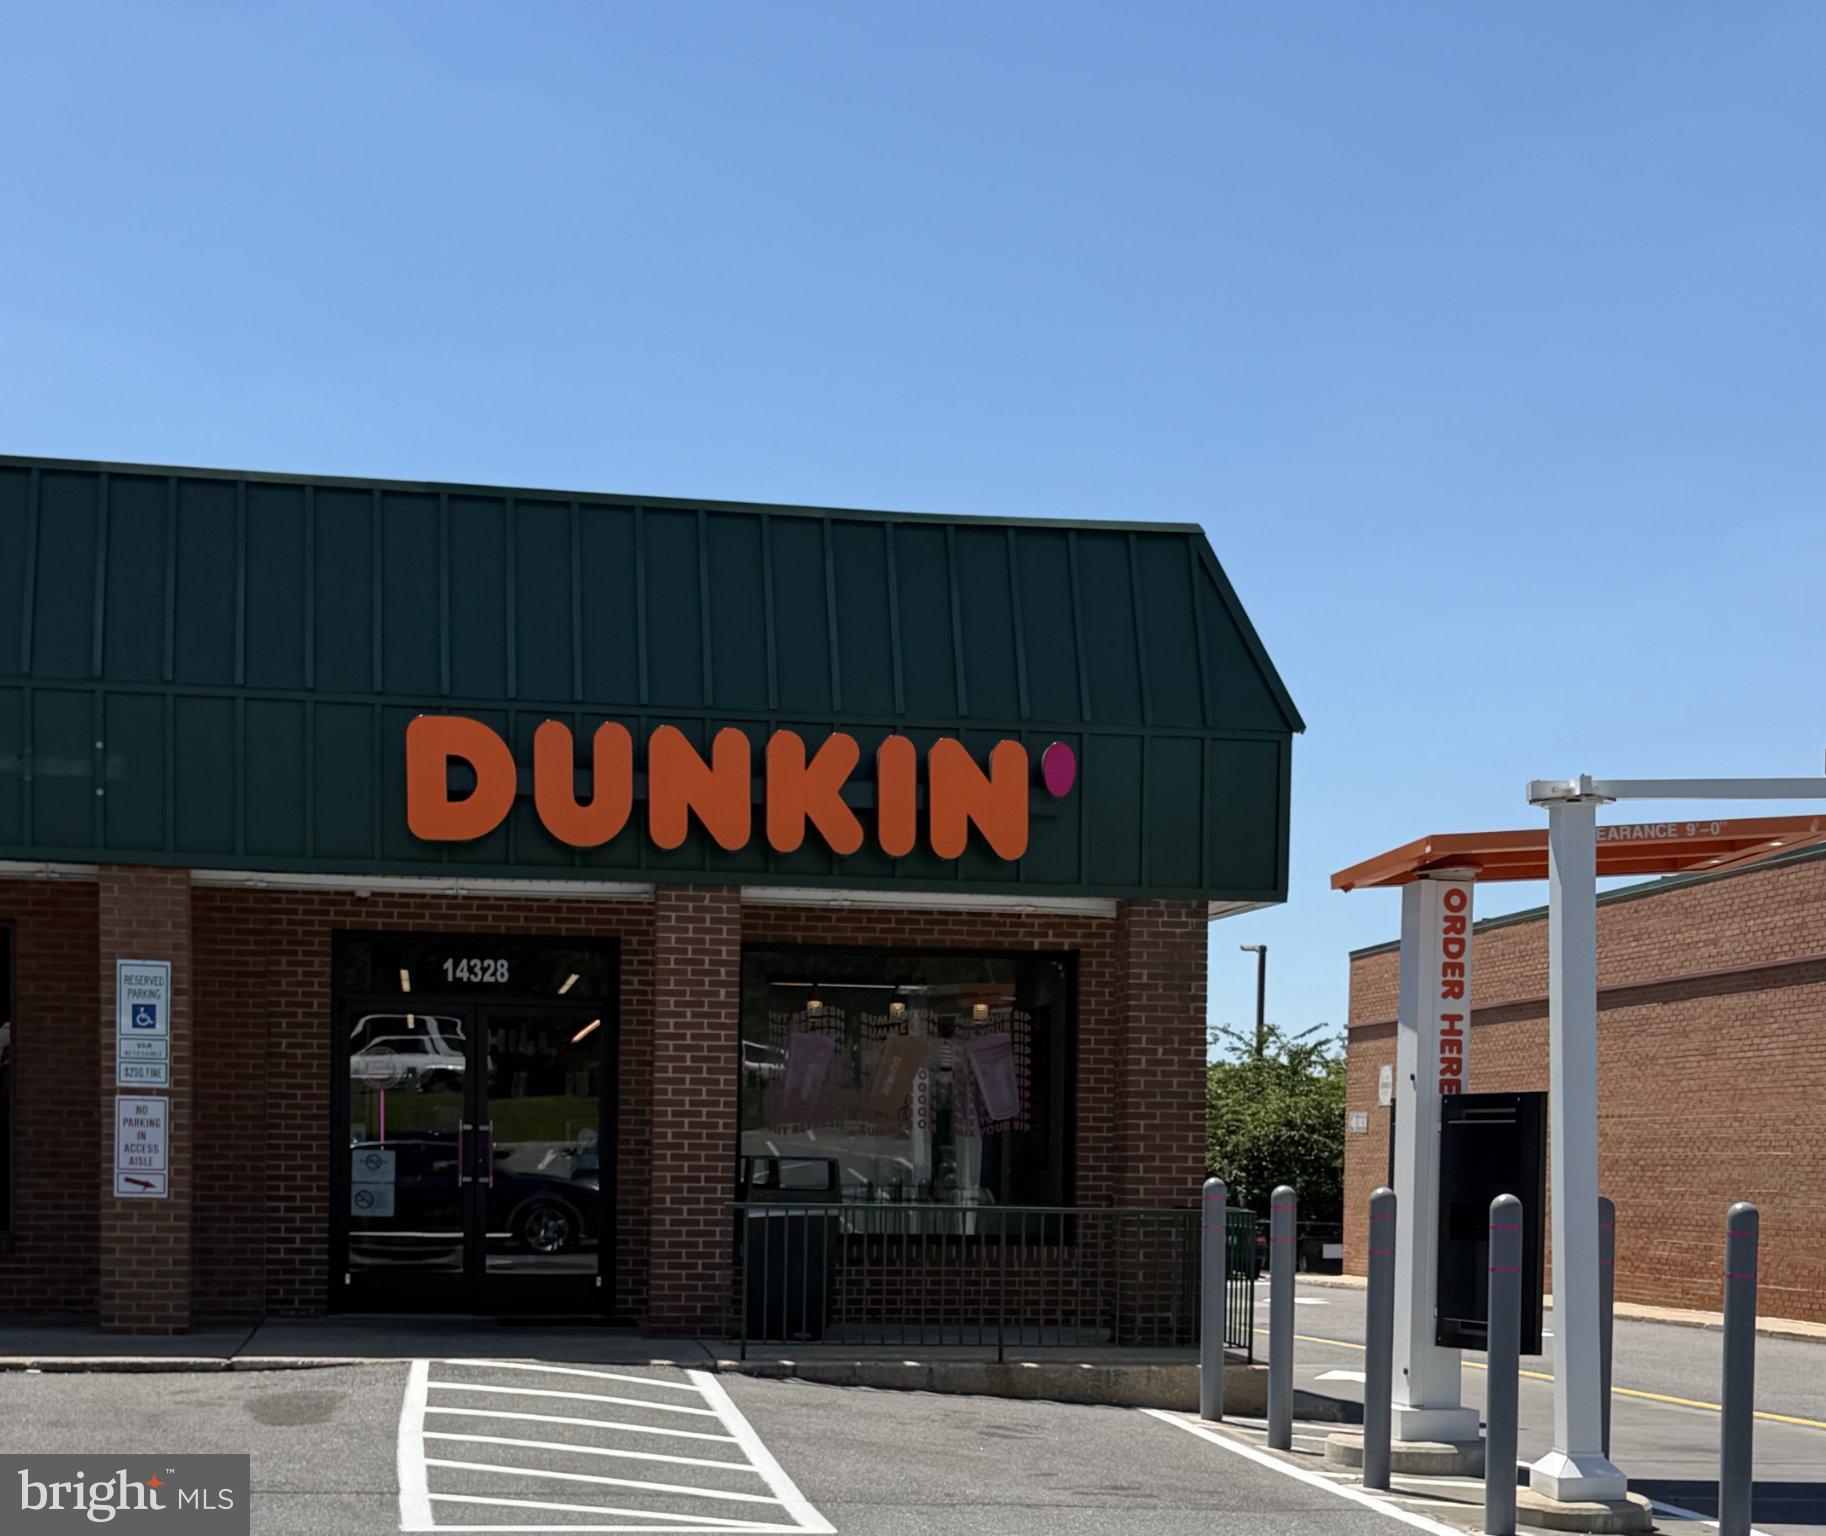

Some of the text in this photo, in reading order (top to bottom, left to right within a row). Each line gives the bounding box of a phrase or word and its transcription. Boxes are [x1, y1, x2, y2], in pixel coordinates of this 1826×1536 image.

[1596, 822, 1678, 841] EARANCE
[443, 957, 509, 983] 14328
[124, 974, 165, 987] RESERVED
[127, 988, 161, 1000] PARKING
[1439, 888, 1467, 1094] ORDER HERE
[136, 1042, 153, 1050] VAN
[124, 1066, 162, 1079] $250 FINE
[136, 1104, 149, 1115] NO
[122, 1116, 161, 1129] PARKING
[136, 1130, 147, 1141] IN
[123, 1143, 160, 1154] ACCESS
[128, 1156, 154, 1168] AISLE
